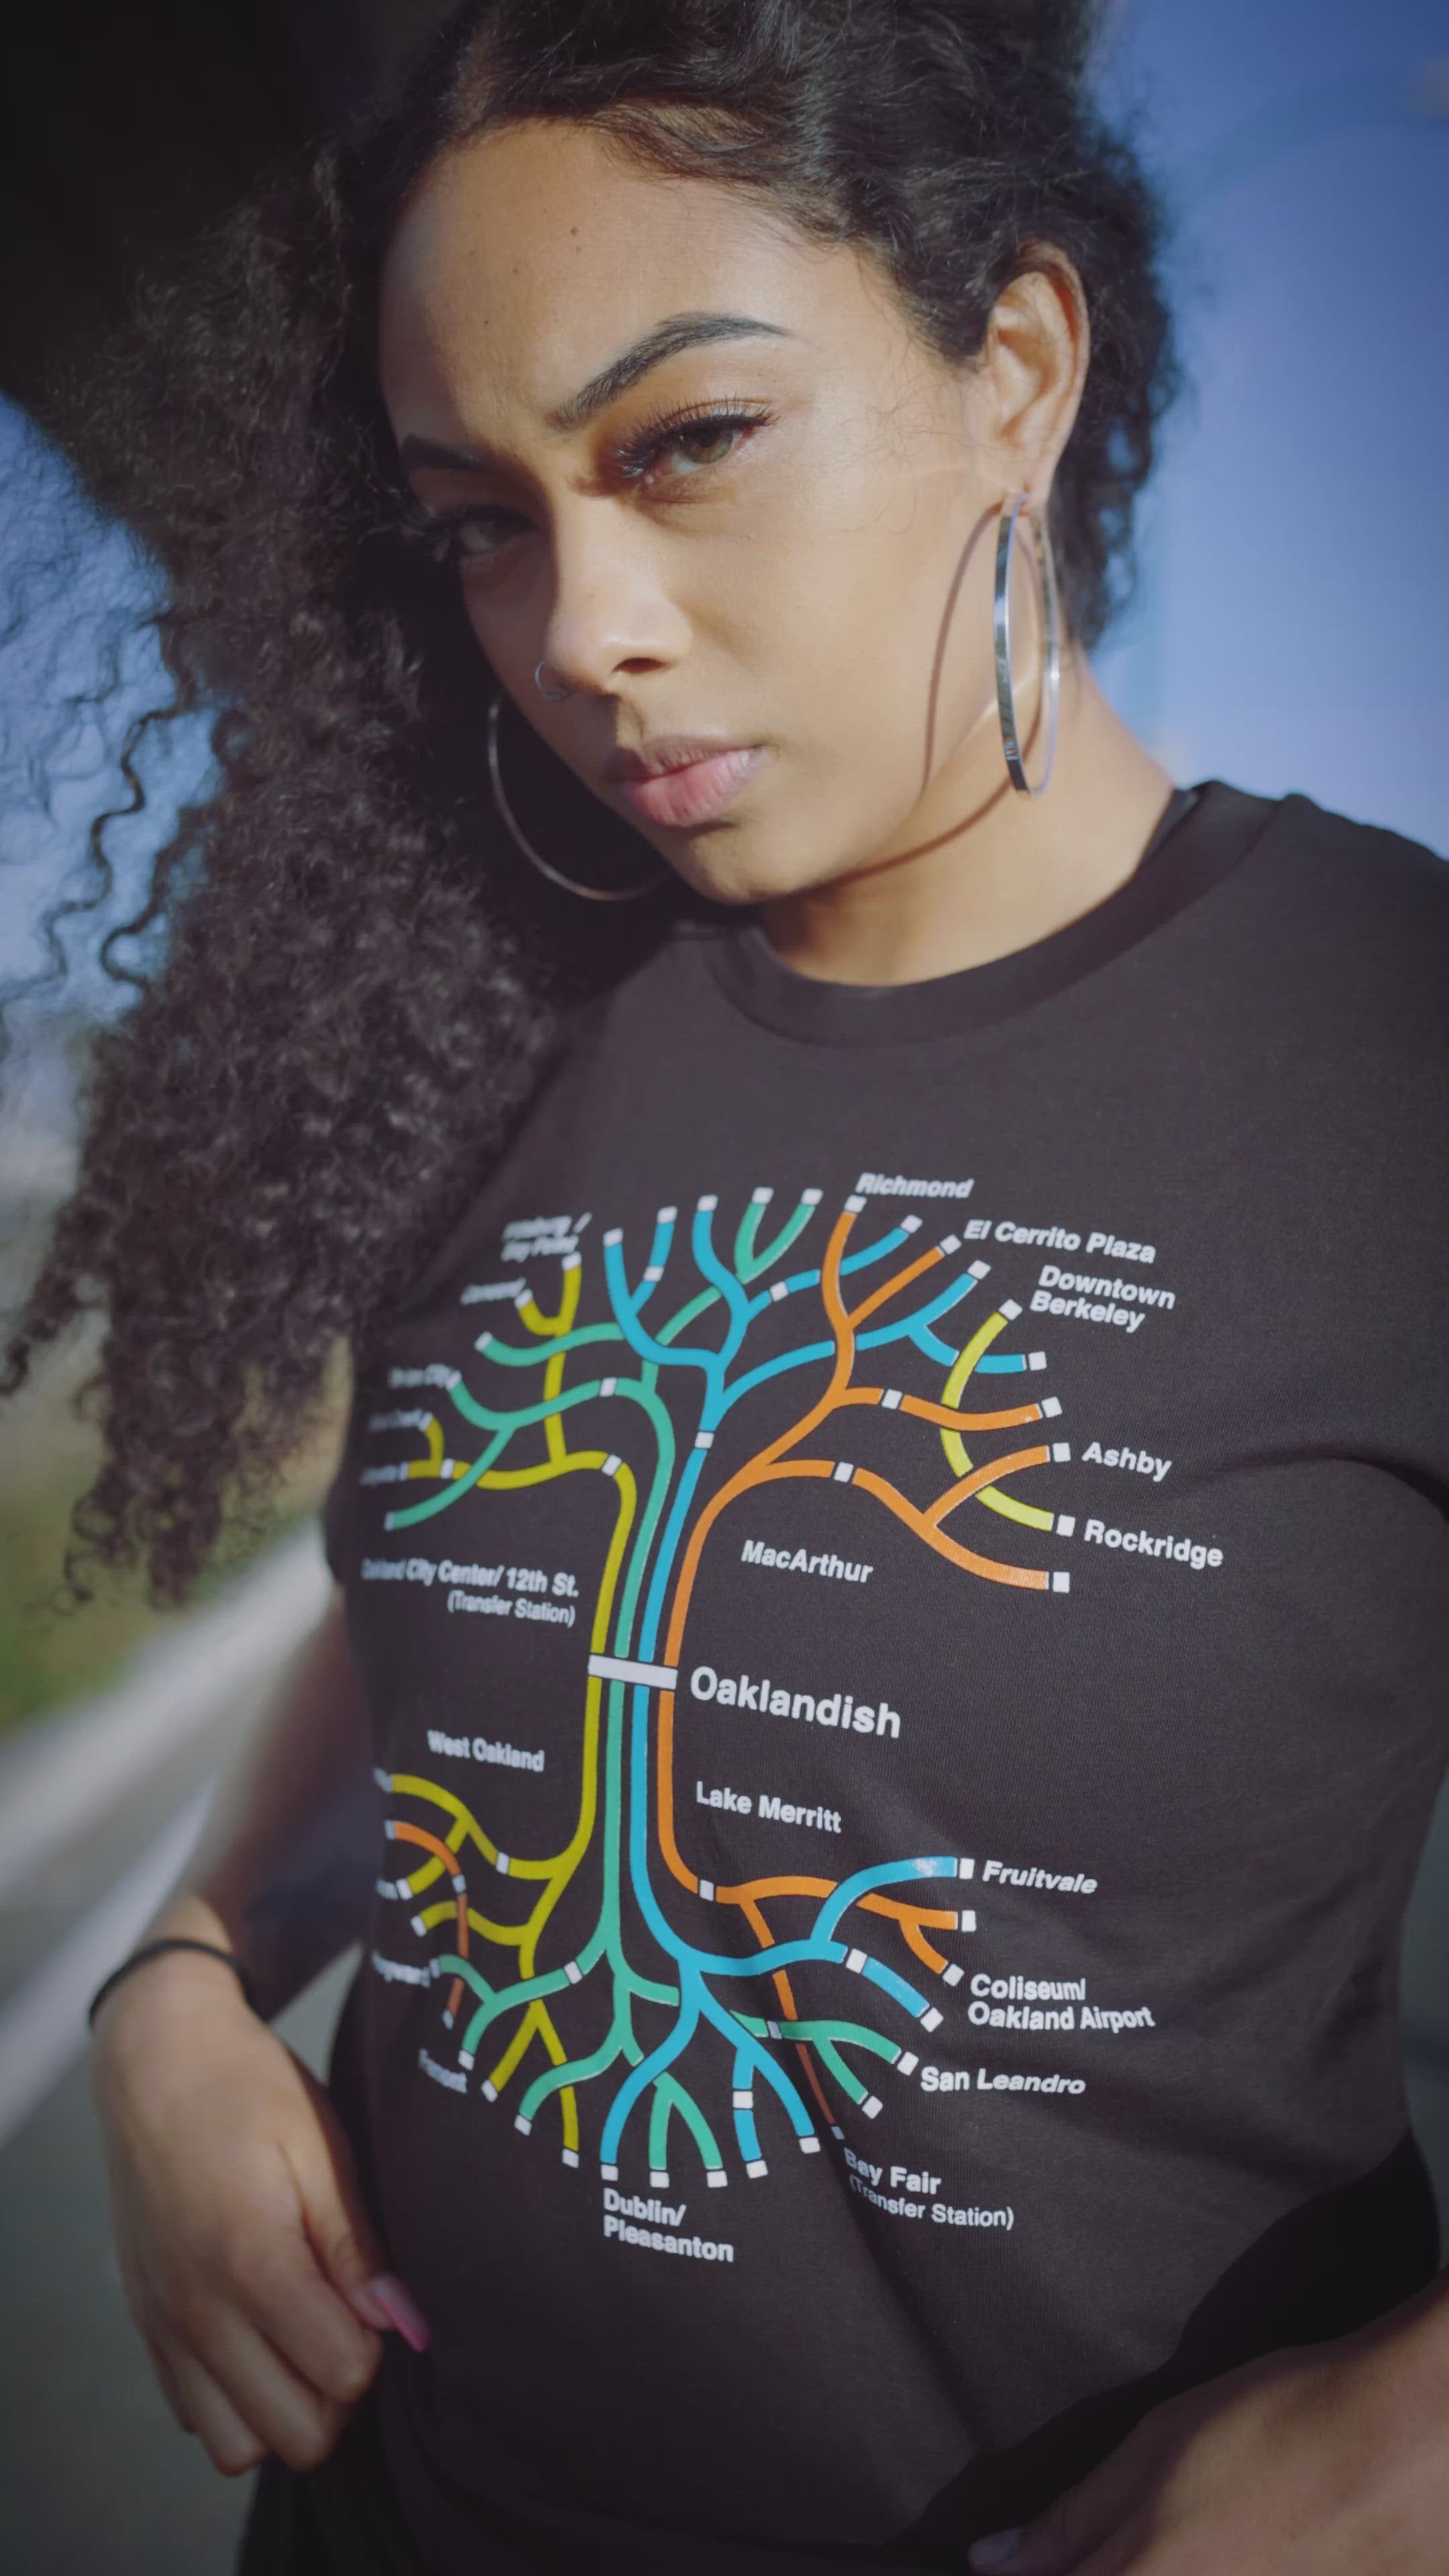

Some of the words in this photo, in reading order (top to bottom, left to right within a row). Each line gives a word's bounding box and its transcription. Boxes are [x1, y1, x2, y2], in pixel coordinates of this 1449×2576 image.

[855, 1173, 974, 1199] Richmond
[964, 1220, 991, 1239] El
[995, 1222, 1081, 1250] Cerrito
[1086, 1232, 1155, 1263] Plaza
[1038, 1265, 1175, 1309] Downtown
[1030, 1290, 1144, 1333] Berkeley
[1081, 1442, 1172, 1482] Ashby
[741, 1540, 873, 1582] MacArthur
[1084, 1519, 1223, 1569] Rockridge
[438, 1560, 504, 1587] Center/
[506, 1568, 547, 1593] 12th
[552, 1572, 579, 1597] St.
[447, 1589, 513, 1615] (Transfer
[515, 1597, 576, 1628] Station)
[691, 1666, 900, 1738] Oaklandish
[427, 1730, 470, 1758] West
[472, 1738, 544, 1772] Oakland
[697, 1781, 752, 1814] Lake
[759, 1795, 841, 1833] Merritt
[982, 1860, 1097, 1894] Fruitvale
[968, 2000, 1074, 2030] Oakland
[1080, 2006, 1155, 2033] Airport
[921, 2066, 969, 2092] San
[977, 2068, 1085, 2094] Leandro
[844, 2147, 883, 2187] Bay
[891, 2166, 941, 2194] Fair
[604, 2188, 686, 2226] Dublin/
[849, 2174, 926, 2219] (Transfer
[932, 2204, 1014, 2231] Station)
[604, 2214, 734, 2263] Pleasanton
